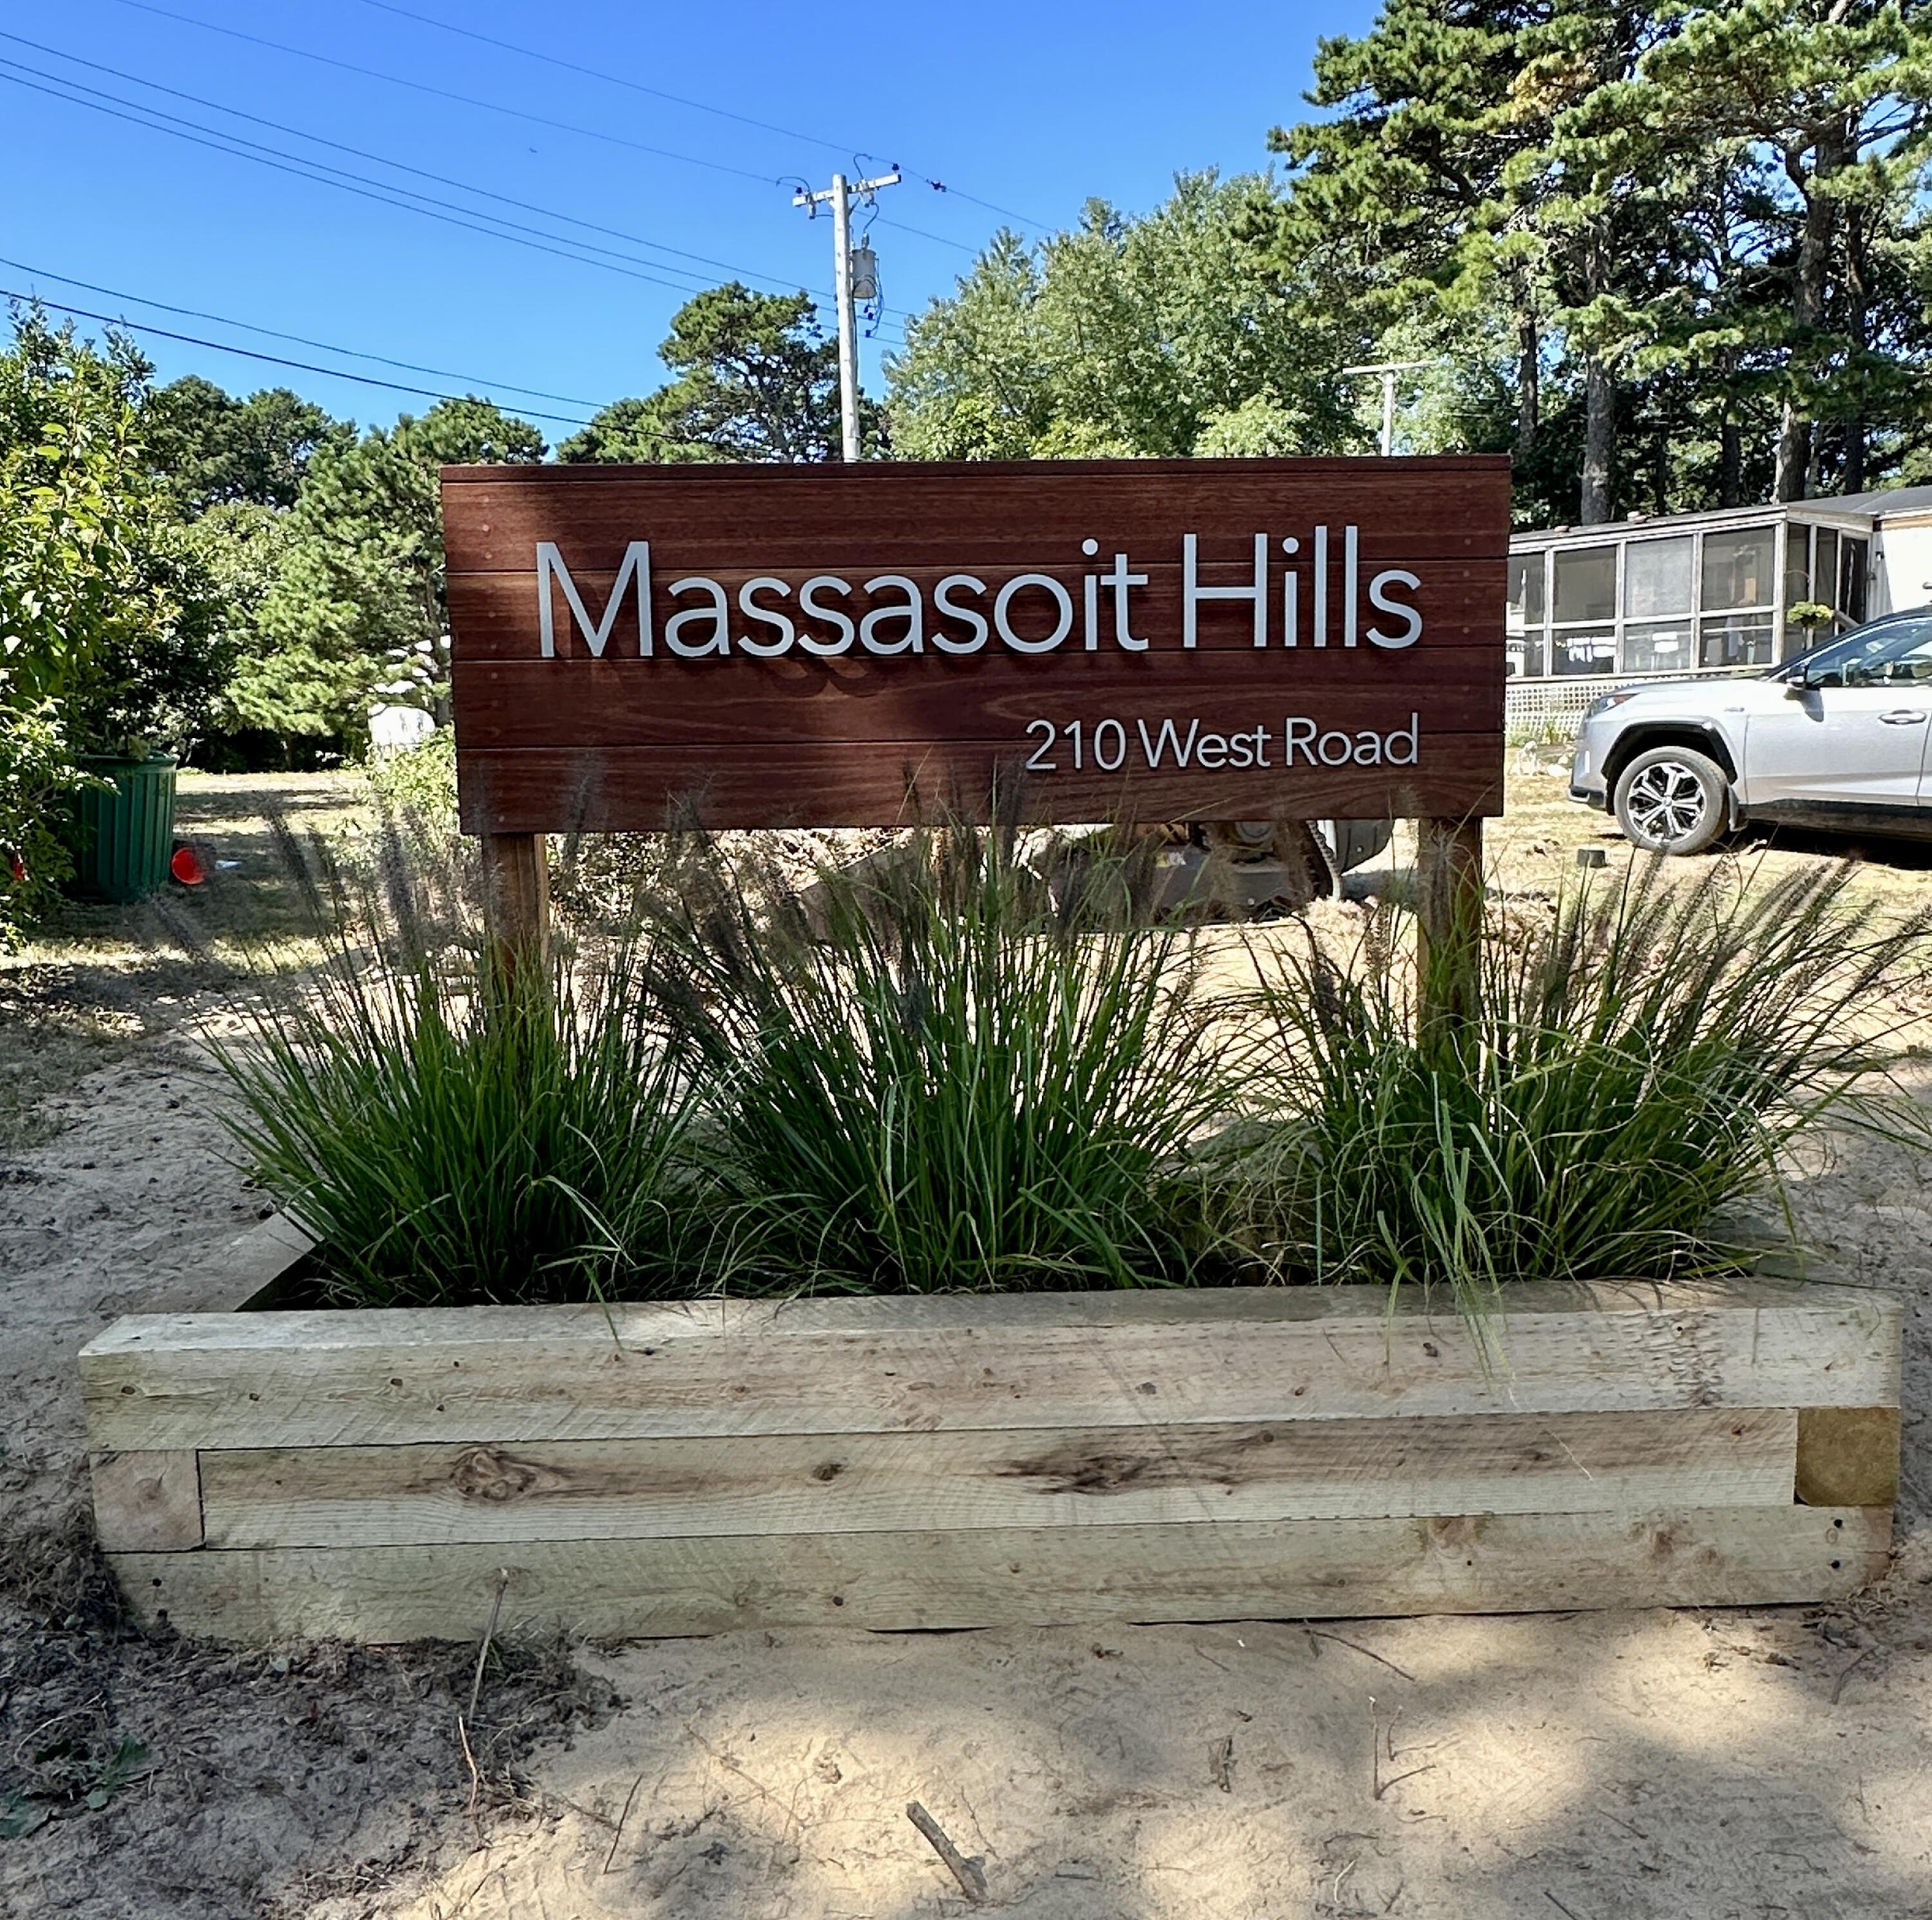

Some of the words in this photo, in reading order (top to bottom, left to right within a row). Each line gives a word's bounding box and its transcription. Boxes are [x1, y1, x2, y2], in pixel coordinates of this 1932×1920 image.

[535, 538, 1150, 658] Massasoit
[1183, 525, 1423, 649] Hills
[1025, 718, 1126, 771] 210
[1137, 718, 1273, 768] West
[1285, 712, 1420, 767] Road
